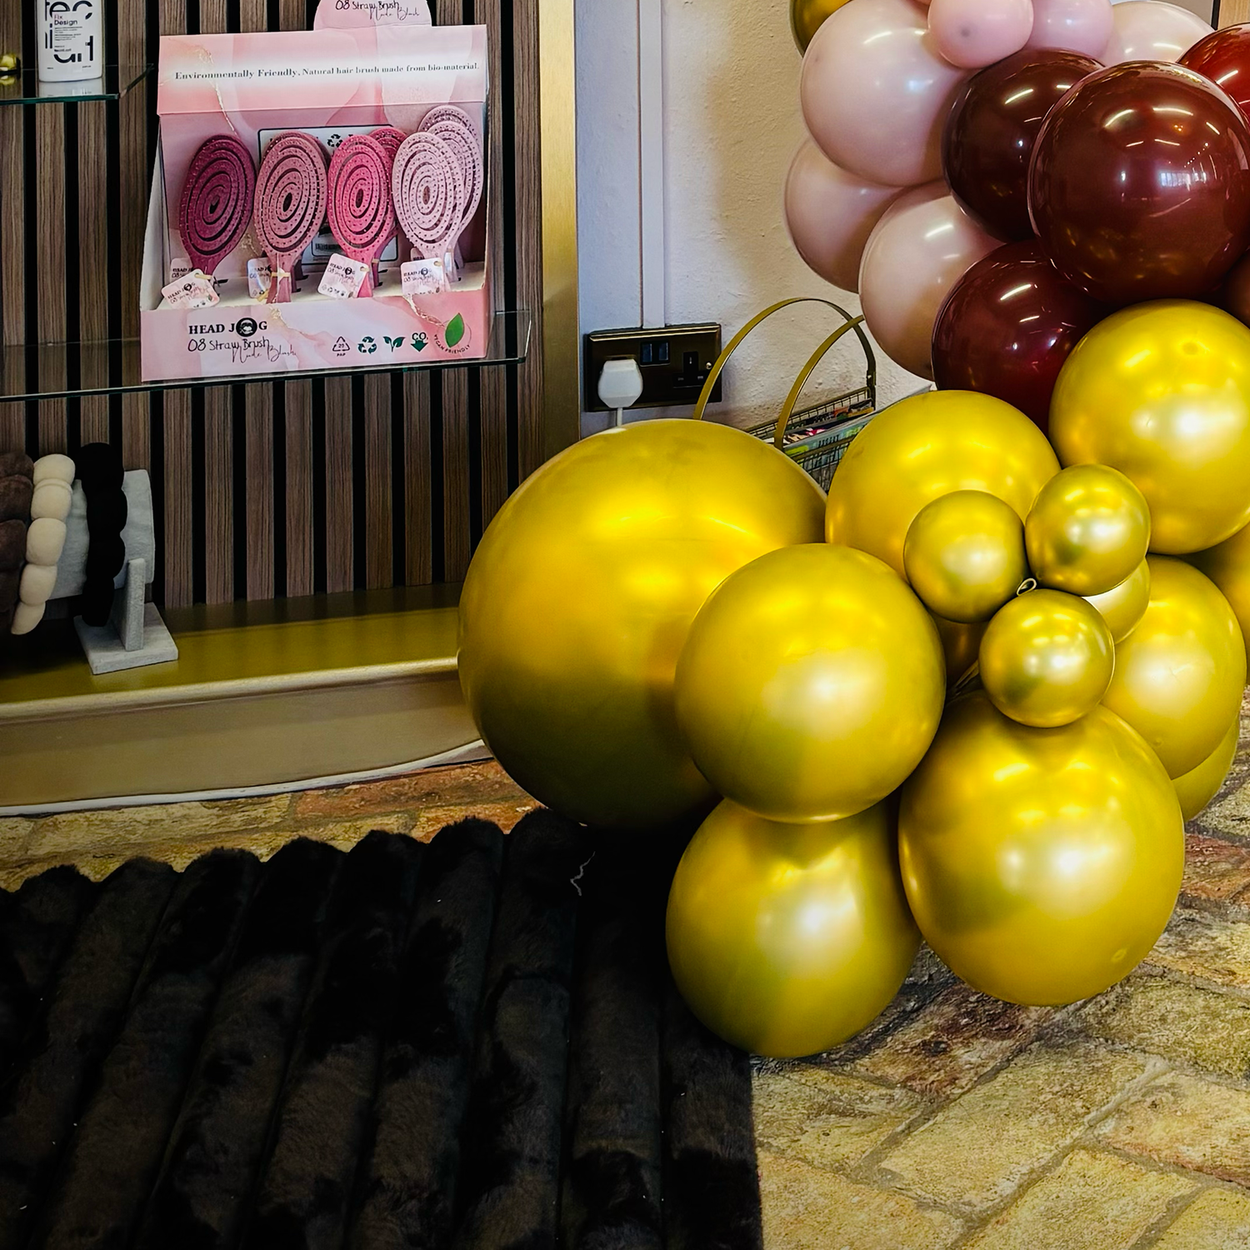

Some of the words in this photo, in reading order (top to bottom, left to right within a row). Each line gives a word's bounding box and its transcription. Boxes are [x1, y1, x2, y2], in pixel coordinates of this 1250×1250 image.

[352, 1, 376, 10] Straw
[378, 0, 399, 10] Brush
[175, 70, 254, 80] Environmentally
[302, 68, 334, 76] Natural
[356, 66, 379, 74] brush
[406, 64, 426, 72] from
[189, 324, 225, 335] HEAD
[209, 340, 240, 351] Straw
[242, 336, 270, 351] Brush
